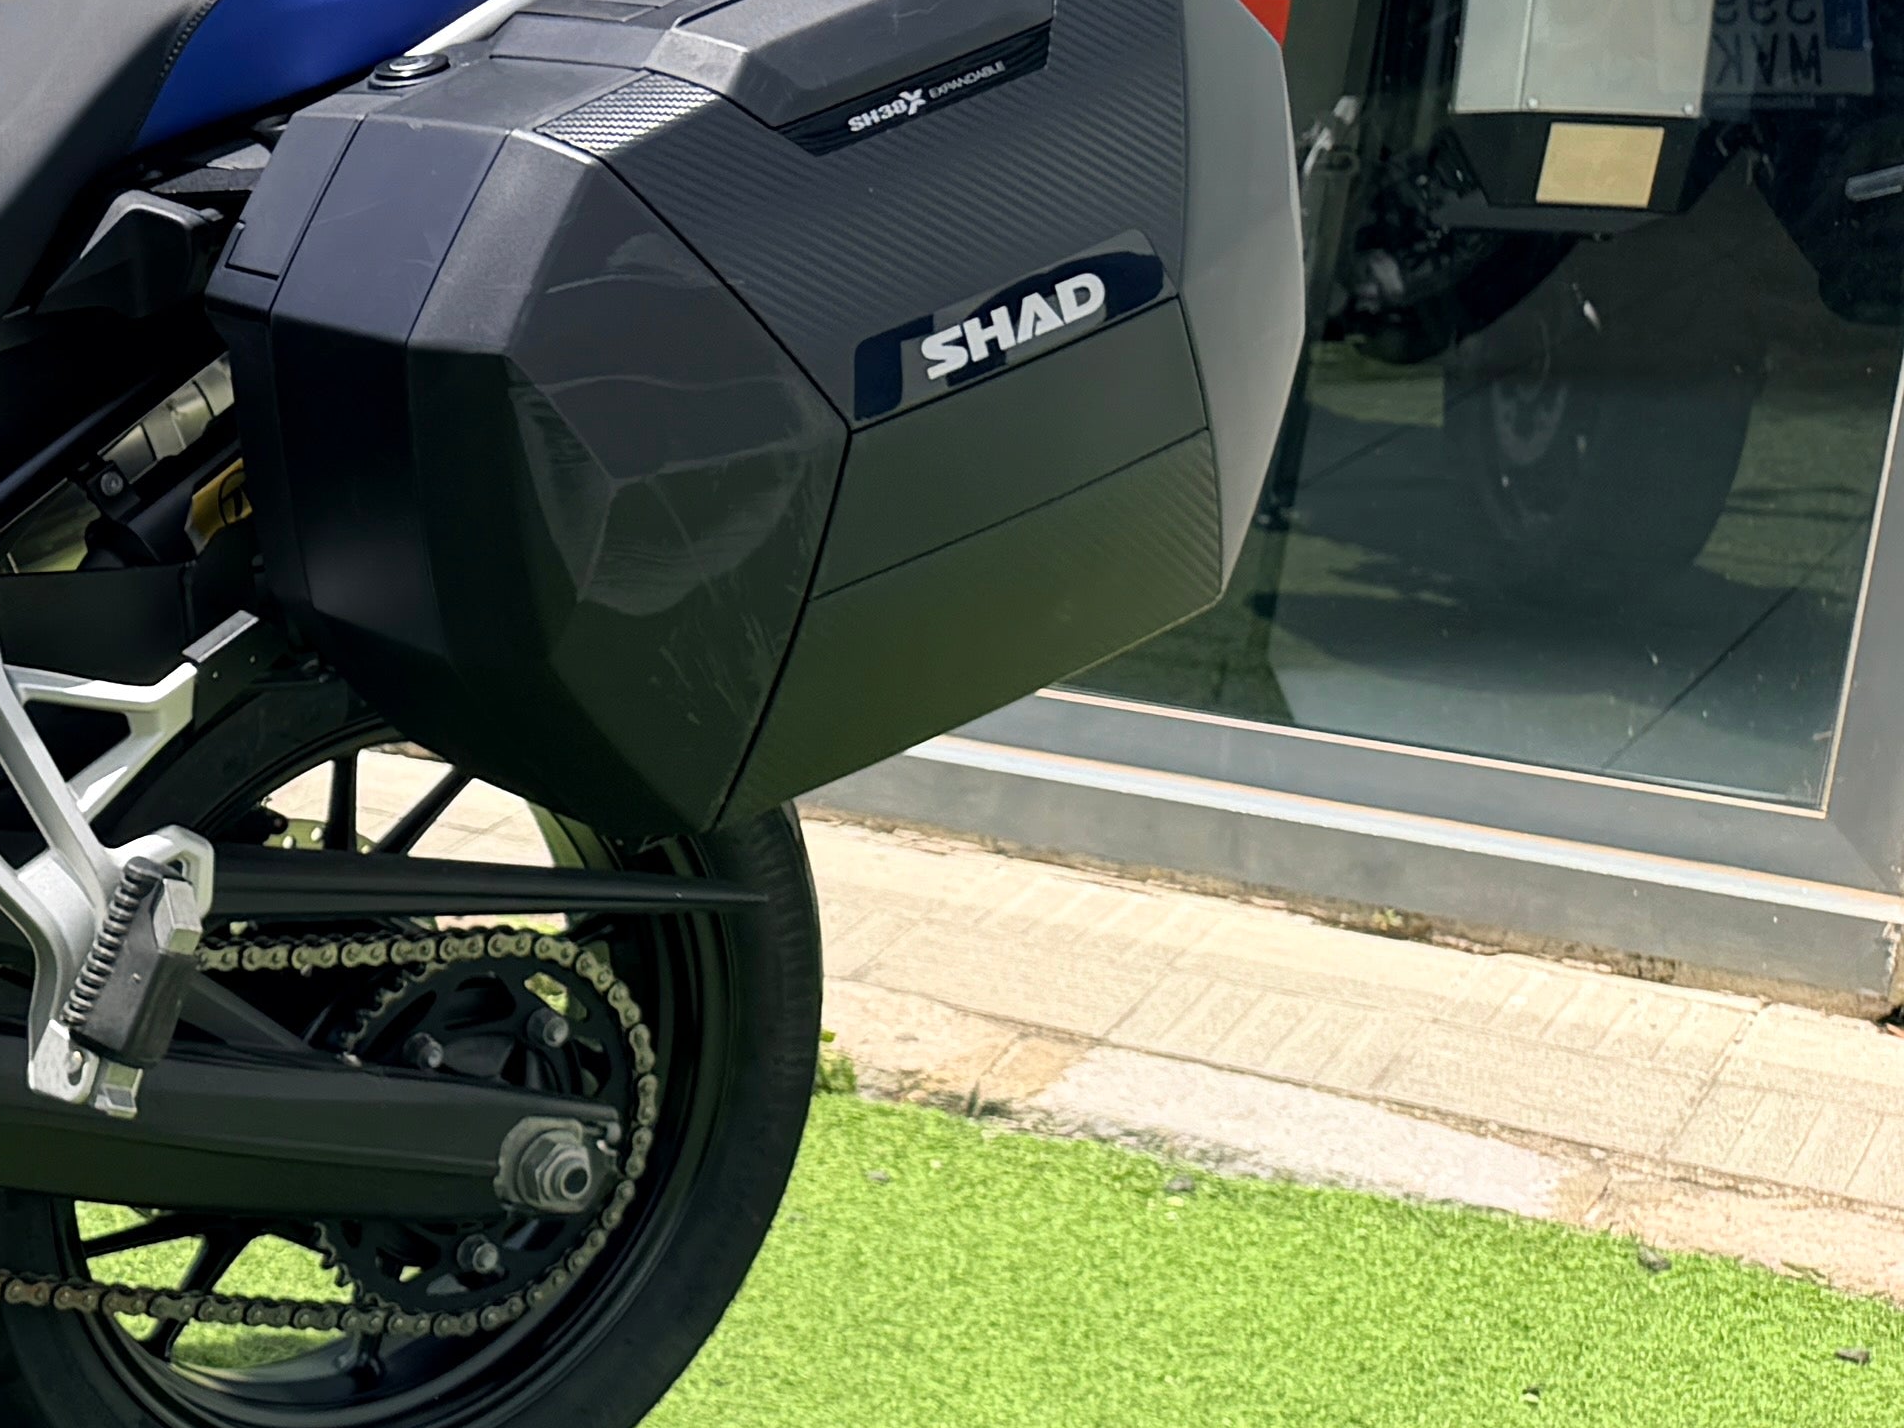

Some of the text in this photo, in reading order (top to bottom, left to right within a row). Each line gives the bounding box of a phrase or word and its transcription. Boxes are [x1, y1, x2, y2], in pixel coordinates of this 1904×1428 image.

[847, 61, 1006, 132] SH38X EXPANDABLE
[921, 273, 1106, 380] SHAD
